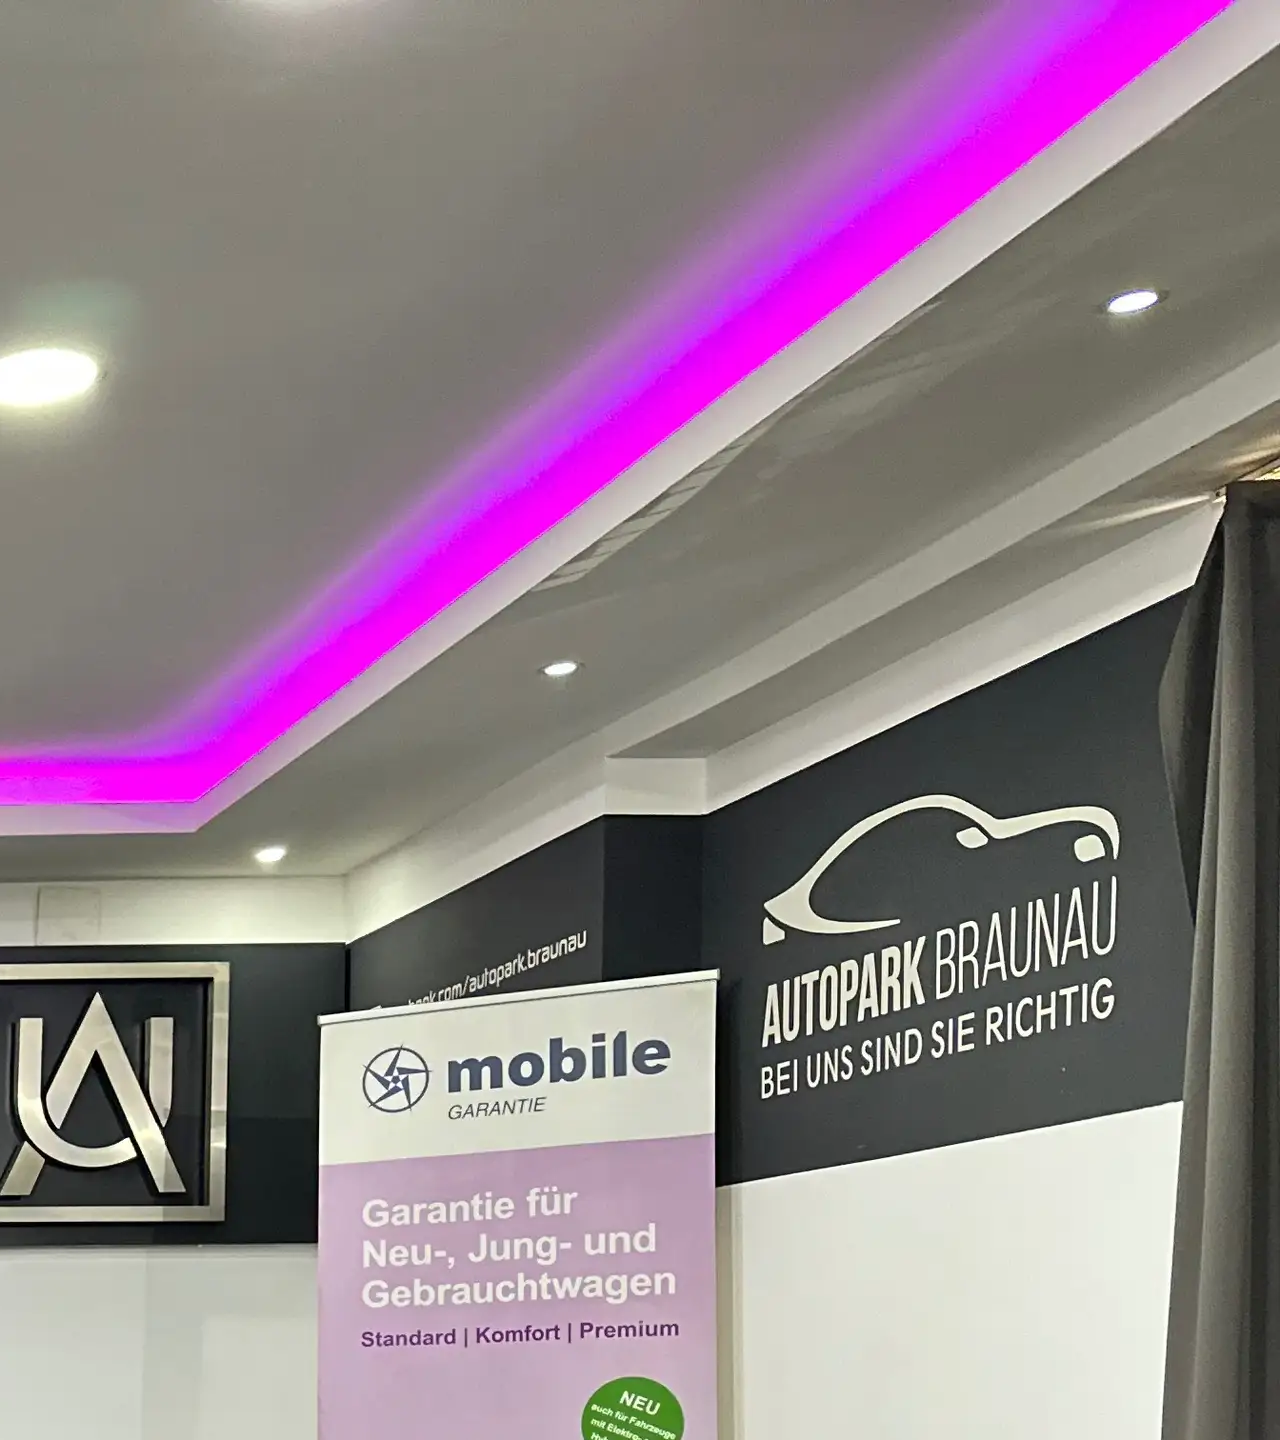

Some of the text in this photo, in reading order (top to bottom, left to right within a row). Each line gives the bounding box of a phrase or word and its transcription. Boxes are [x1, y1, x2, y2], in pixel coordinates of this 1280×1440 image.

[761, 875, 1117, 1048] AUTOPARK BRAUNAU
[761, 977, 1115, 1099] BEI UNS SIND SIE RICHTIG
[447, 1030, 671, 1093] mobile
[447, 1096, 547, 1120] GARANTIE
[362, 1186, 578, 1227] Garantie für
[362, 1223, 656, 1269] Neu-, Jung- und
[362, 1272, 676, 1308] Gebrauchtwagen
[361, 1329, 457, 1348] Standard
[476, 1325, 561, 1344] Komfort
[580, 1321, 679, 1339] Premium
[619, 1390, 661, 1415] NEU
[590, 1418, 607, 1429] mit
[591, 1403, 676, 1440] auch für Fahrzeuge
